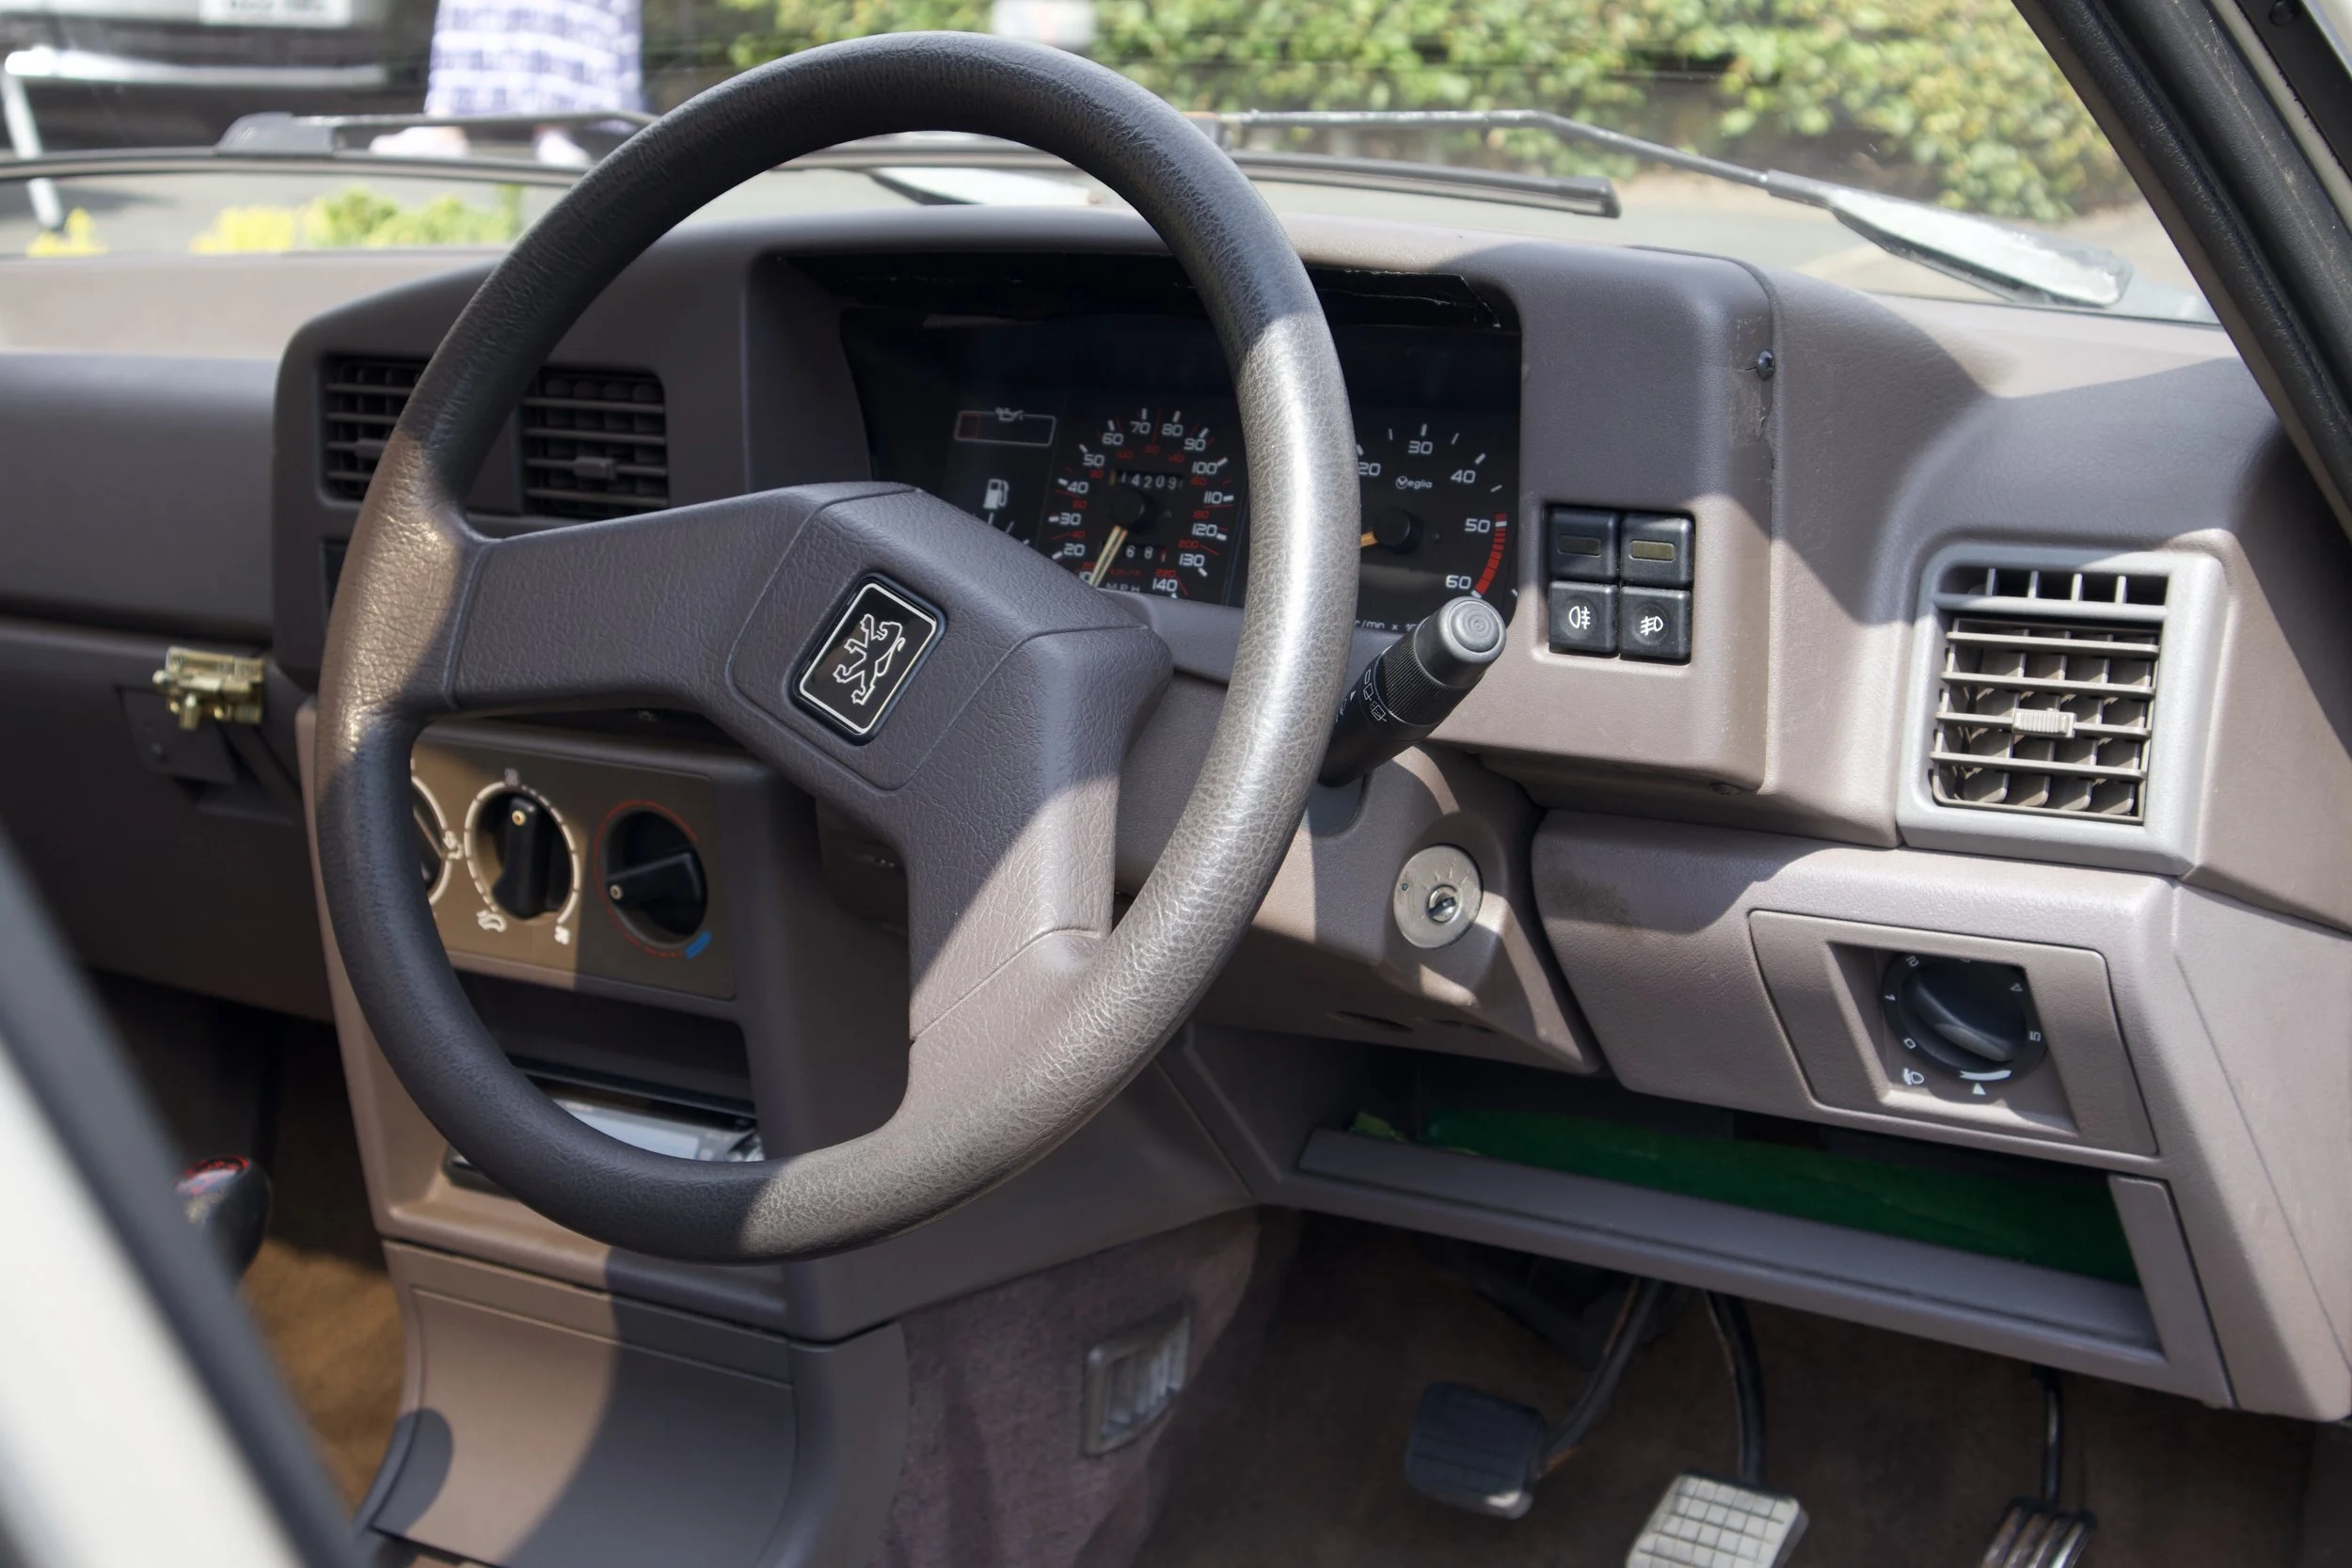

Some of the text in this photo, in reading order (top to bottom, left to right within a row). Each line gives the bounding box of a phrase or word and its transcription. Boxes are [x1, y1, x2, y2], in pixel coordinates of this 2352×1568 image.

[1130, 420, 1151, 434] 70
[1162, 422, 1184, 436] 80
[1102, 432, 1124, 445] 60
[1184, 437, 1206, 451] 90
[1408, 440, 1433, 454] 30
[1083, 453, 1105, 467] 50
[1192, 462, 1218, 475] 100
[1359, 462, 1381, 476] 20
[1451, 469, 1476, 483] 40
[1067, 481, 1089, 494] 40
[1203, 491, 1222, 504] 110
[1059, 512, 1082, 525] 30
[1465, 518, 1490, 532] 50
[1191, 523, 1217, 537] 120
[1063, 543, 1086, 557] 20
[1179, 553, 1205, 567] 130
[1152, 578, 1178, 592] 140
[1445, 575, 1471, 590] 60
